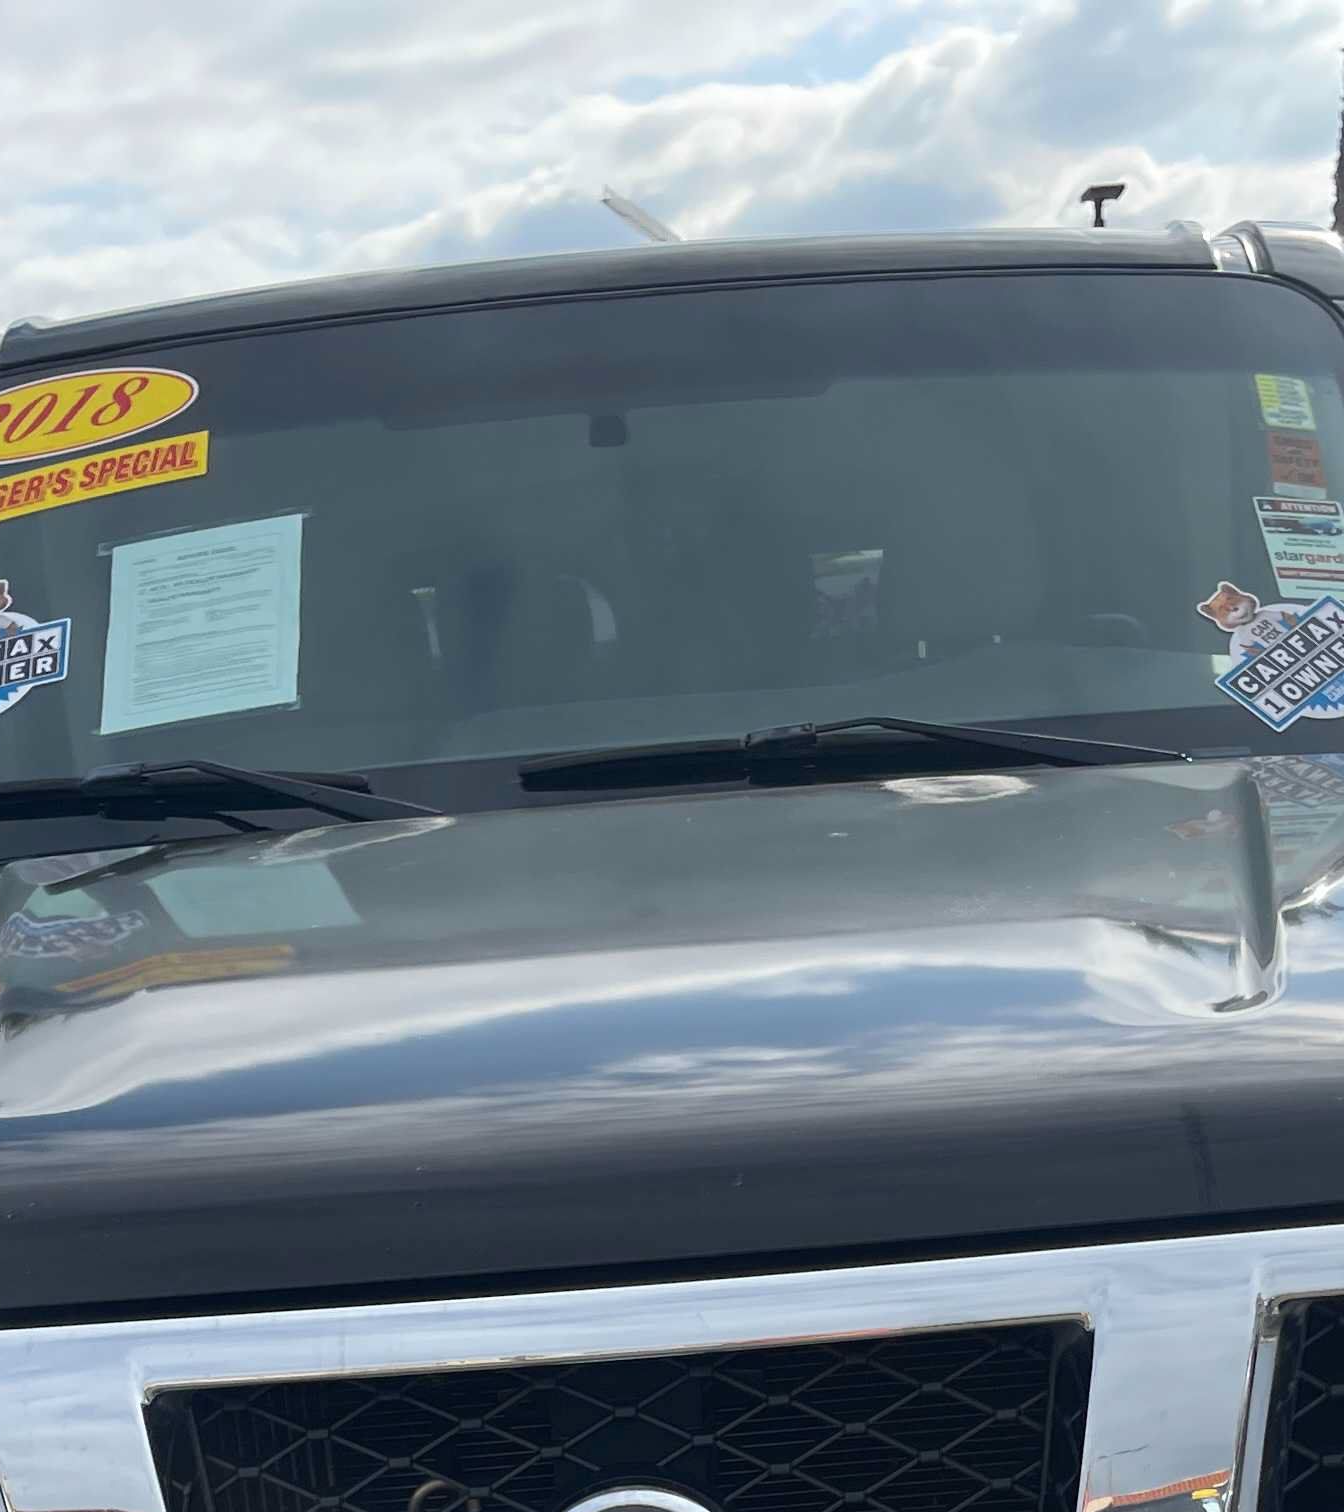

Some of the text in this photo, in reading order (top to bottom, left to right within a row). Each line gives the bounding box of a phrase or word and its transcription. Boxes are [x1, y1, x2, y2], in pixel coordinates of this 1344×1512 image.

[79, 440, 198, 490] SPECIAL
[1250, 619, 1273, 637] CAR
[1261, 628, 1282, 643] FOX
